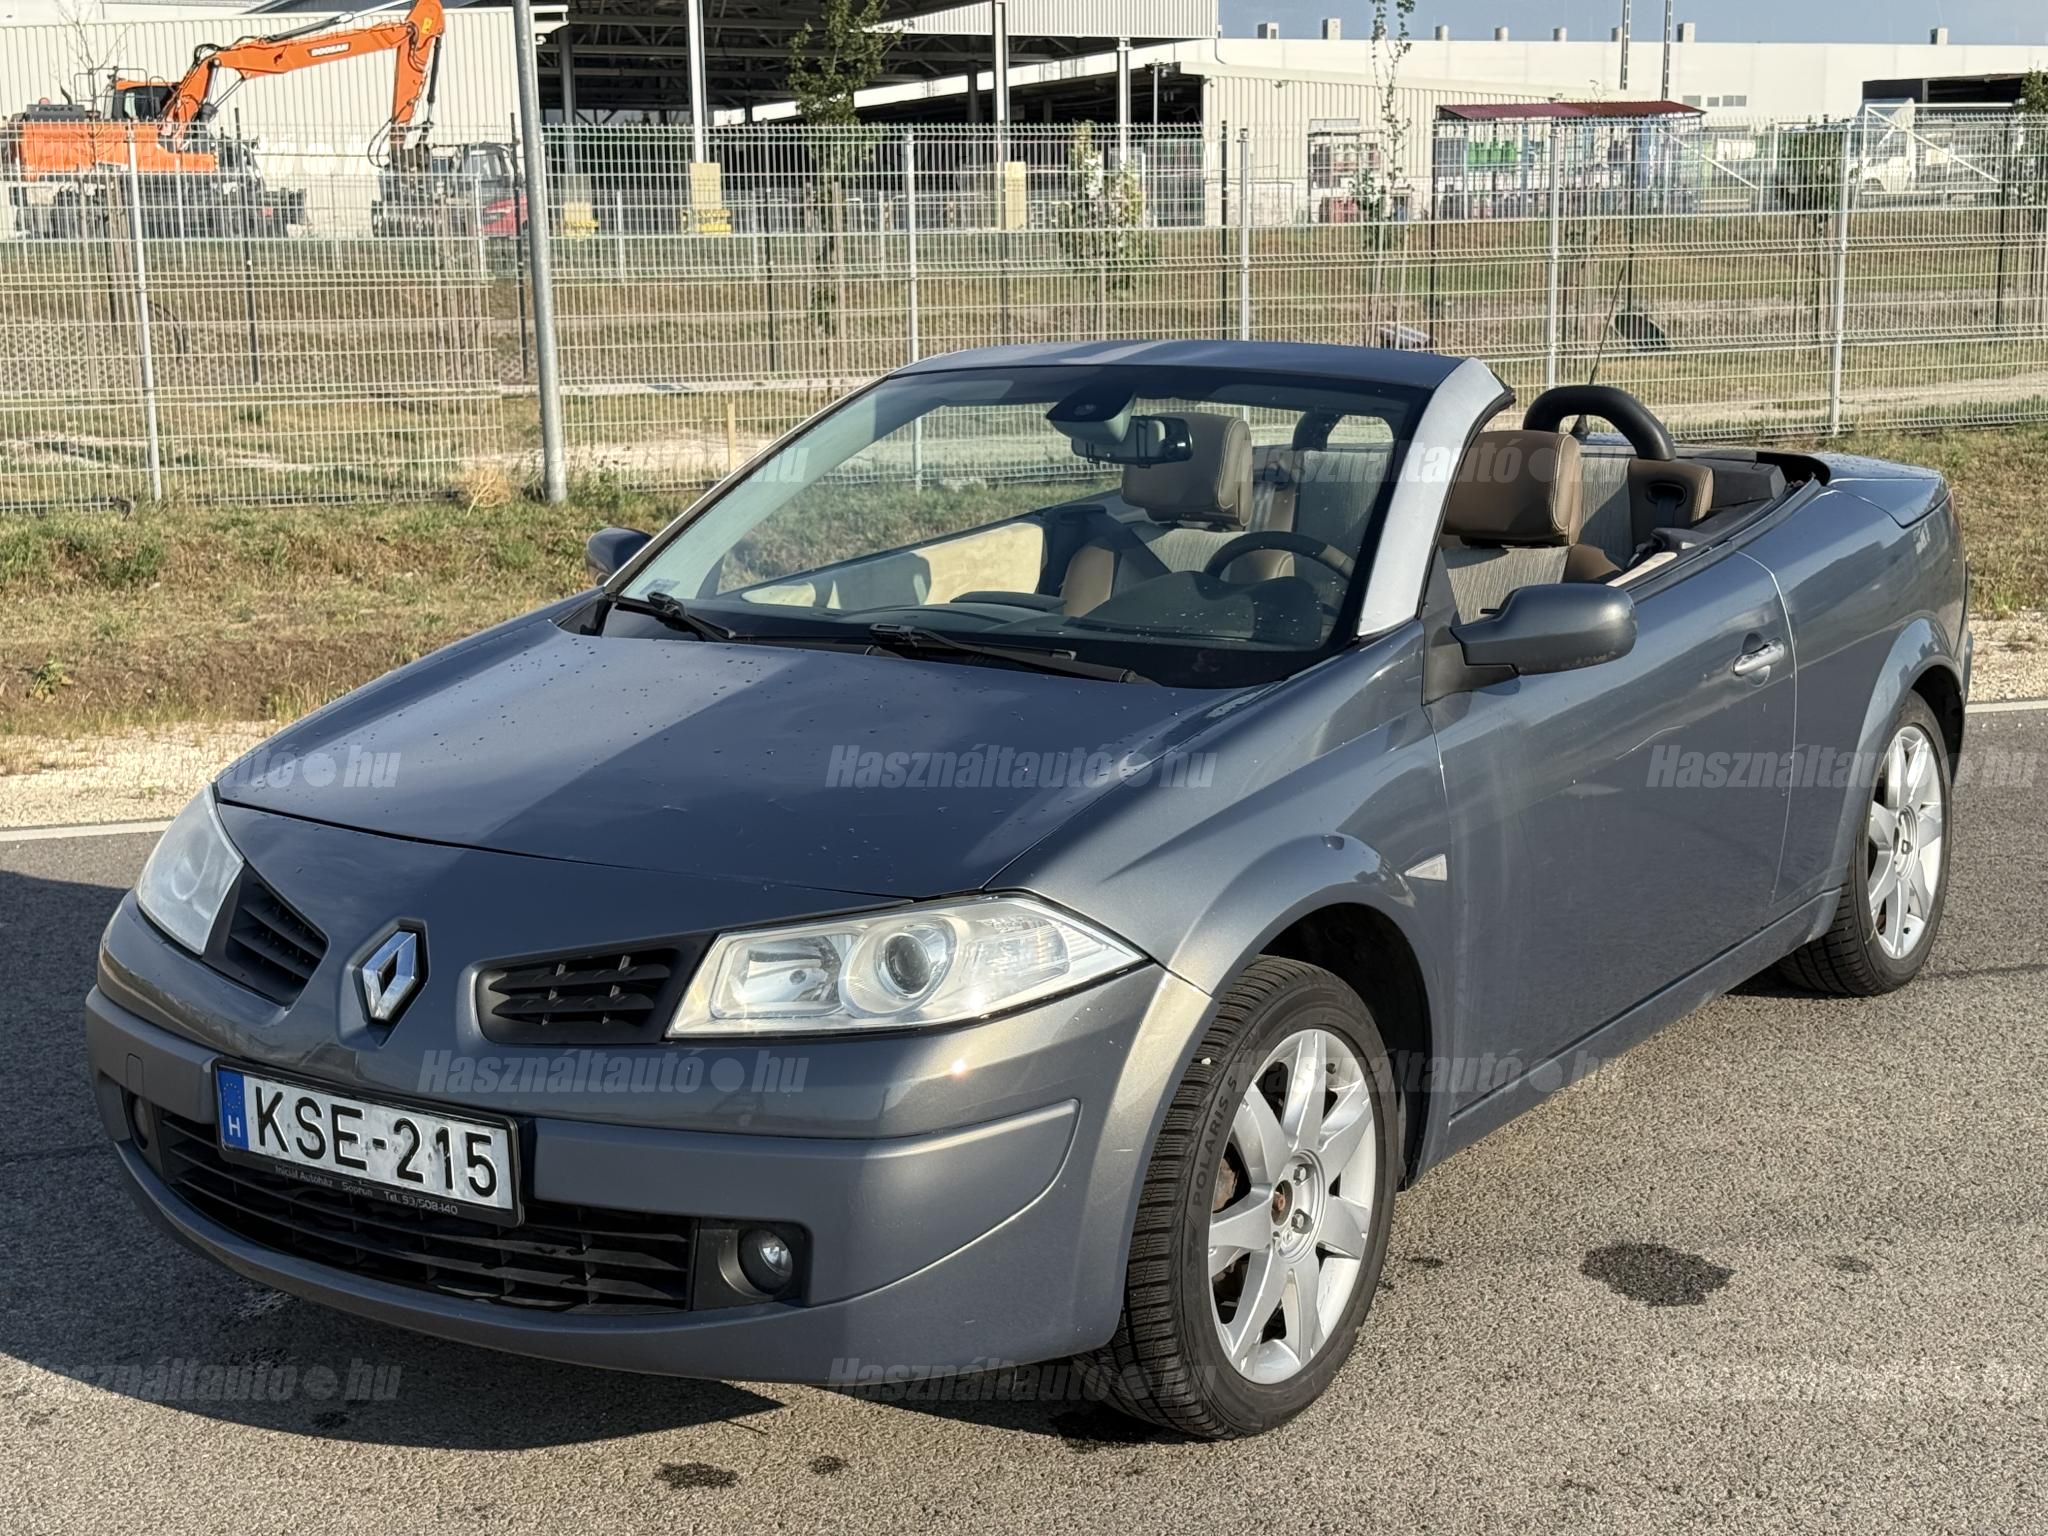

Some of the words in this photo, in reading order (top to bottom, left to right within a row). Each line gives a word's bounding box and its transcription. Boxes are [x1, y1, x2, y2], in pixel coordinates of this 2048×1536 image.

[229, 1115, 241, 1138] H
[255, 1086, 498, 1198] KSE-215
[1193, 1096, 1228, 1206] POLARIS
